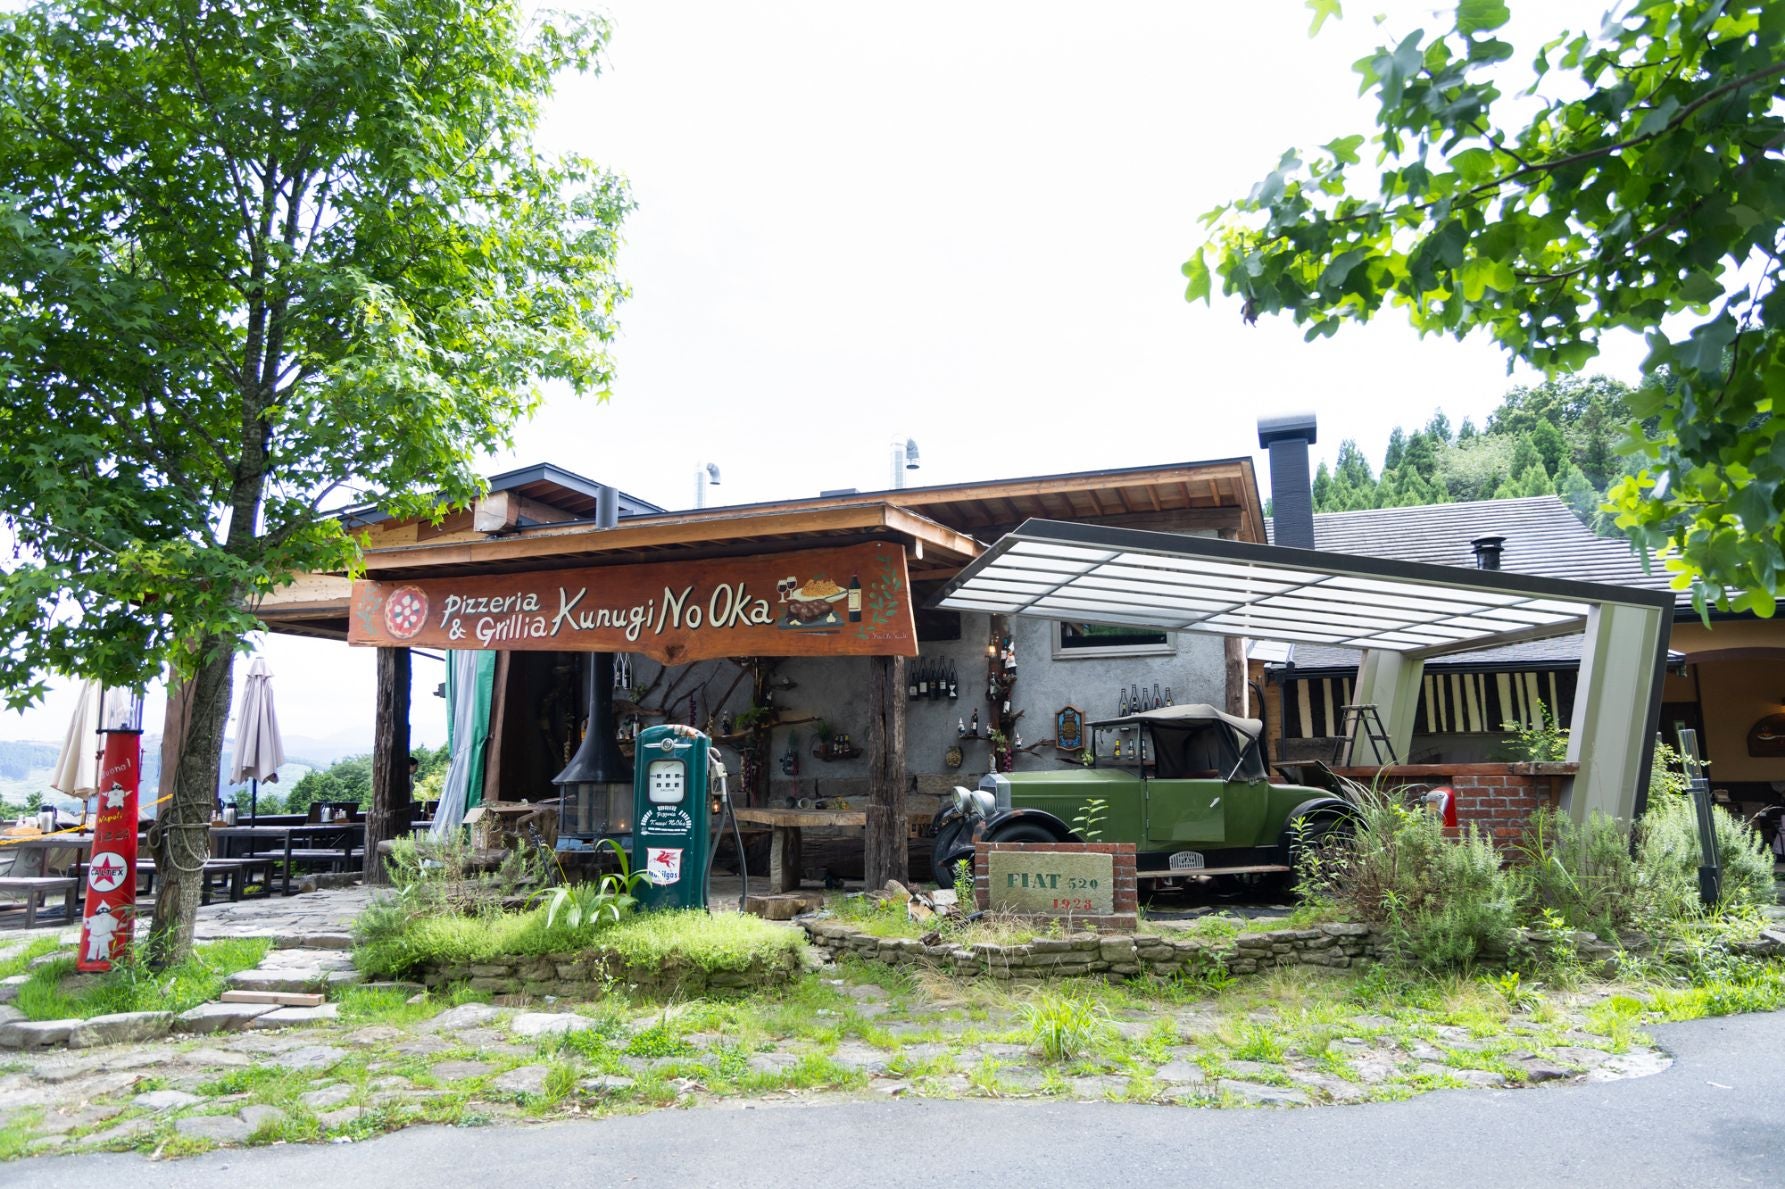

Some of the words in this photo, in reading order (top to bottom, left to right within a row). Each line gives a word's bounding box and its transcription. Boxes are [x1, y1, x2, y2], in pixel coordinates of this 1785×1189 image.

[550, 586, 654, 642] Kunugi
[655, 585, 702, 635] No
[708, 582, 775, 628] Oka
[449, 618, 466, 640] &
[476, 614, 548, 647] Grillia
[91, 868, 124, 877] CALTEX
[648, 869, 678, 880] Moilgas
[1007, 873, 1061, 890] FIAT
[1068, 877, 1099, 890] 520
